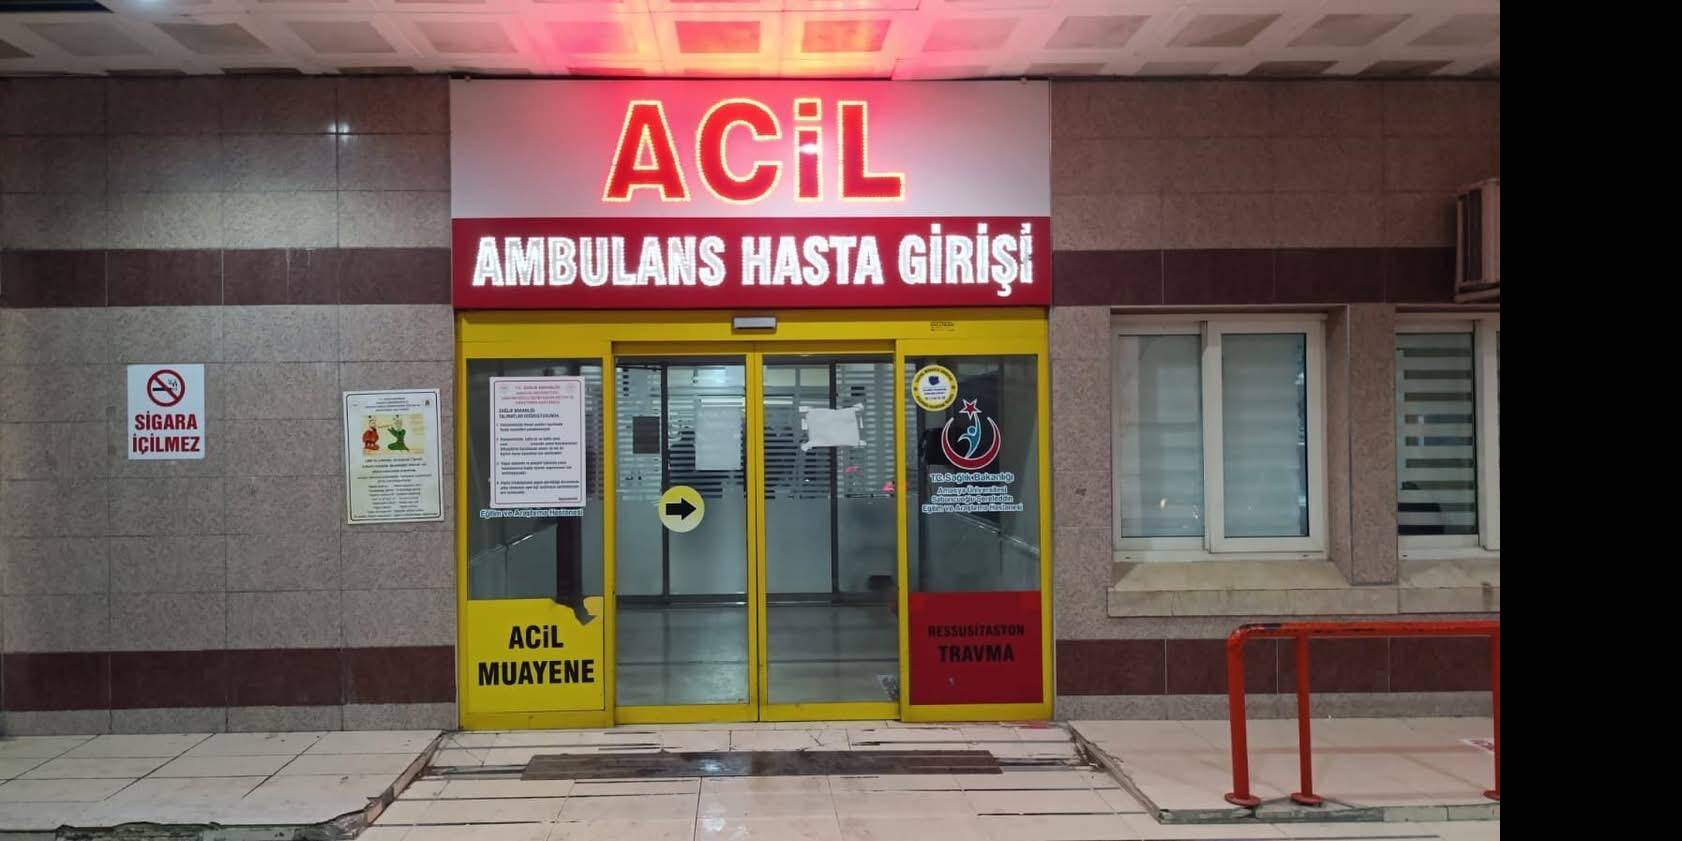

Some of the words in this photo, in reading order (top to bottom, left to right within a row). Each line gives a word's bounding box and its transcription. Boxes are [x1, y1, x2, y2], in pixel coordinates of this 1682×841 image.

[472, 236, 726, 288] AMBULANS
[741, 235, 884, 287] HASTA
[897, 222, 1035, 297] GİRİŞİ
[134, 411, 198, 431] SİGARA
[132, 433, 200, 455] İÇİLMEZ
[938, 644, 1015, 663] TRAVMA
[478, 659, 595, 686] MUAYENE
